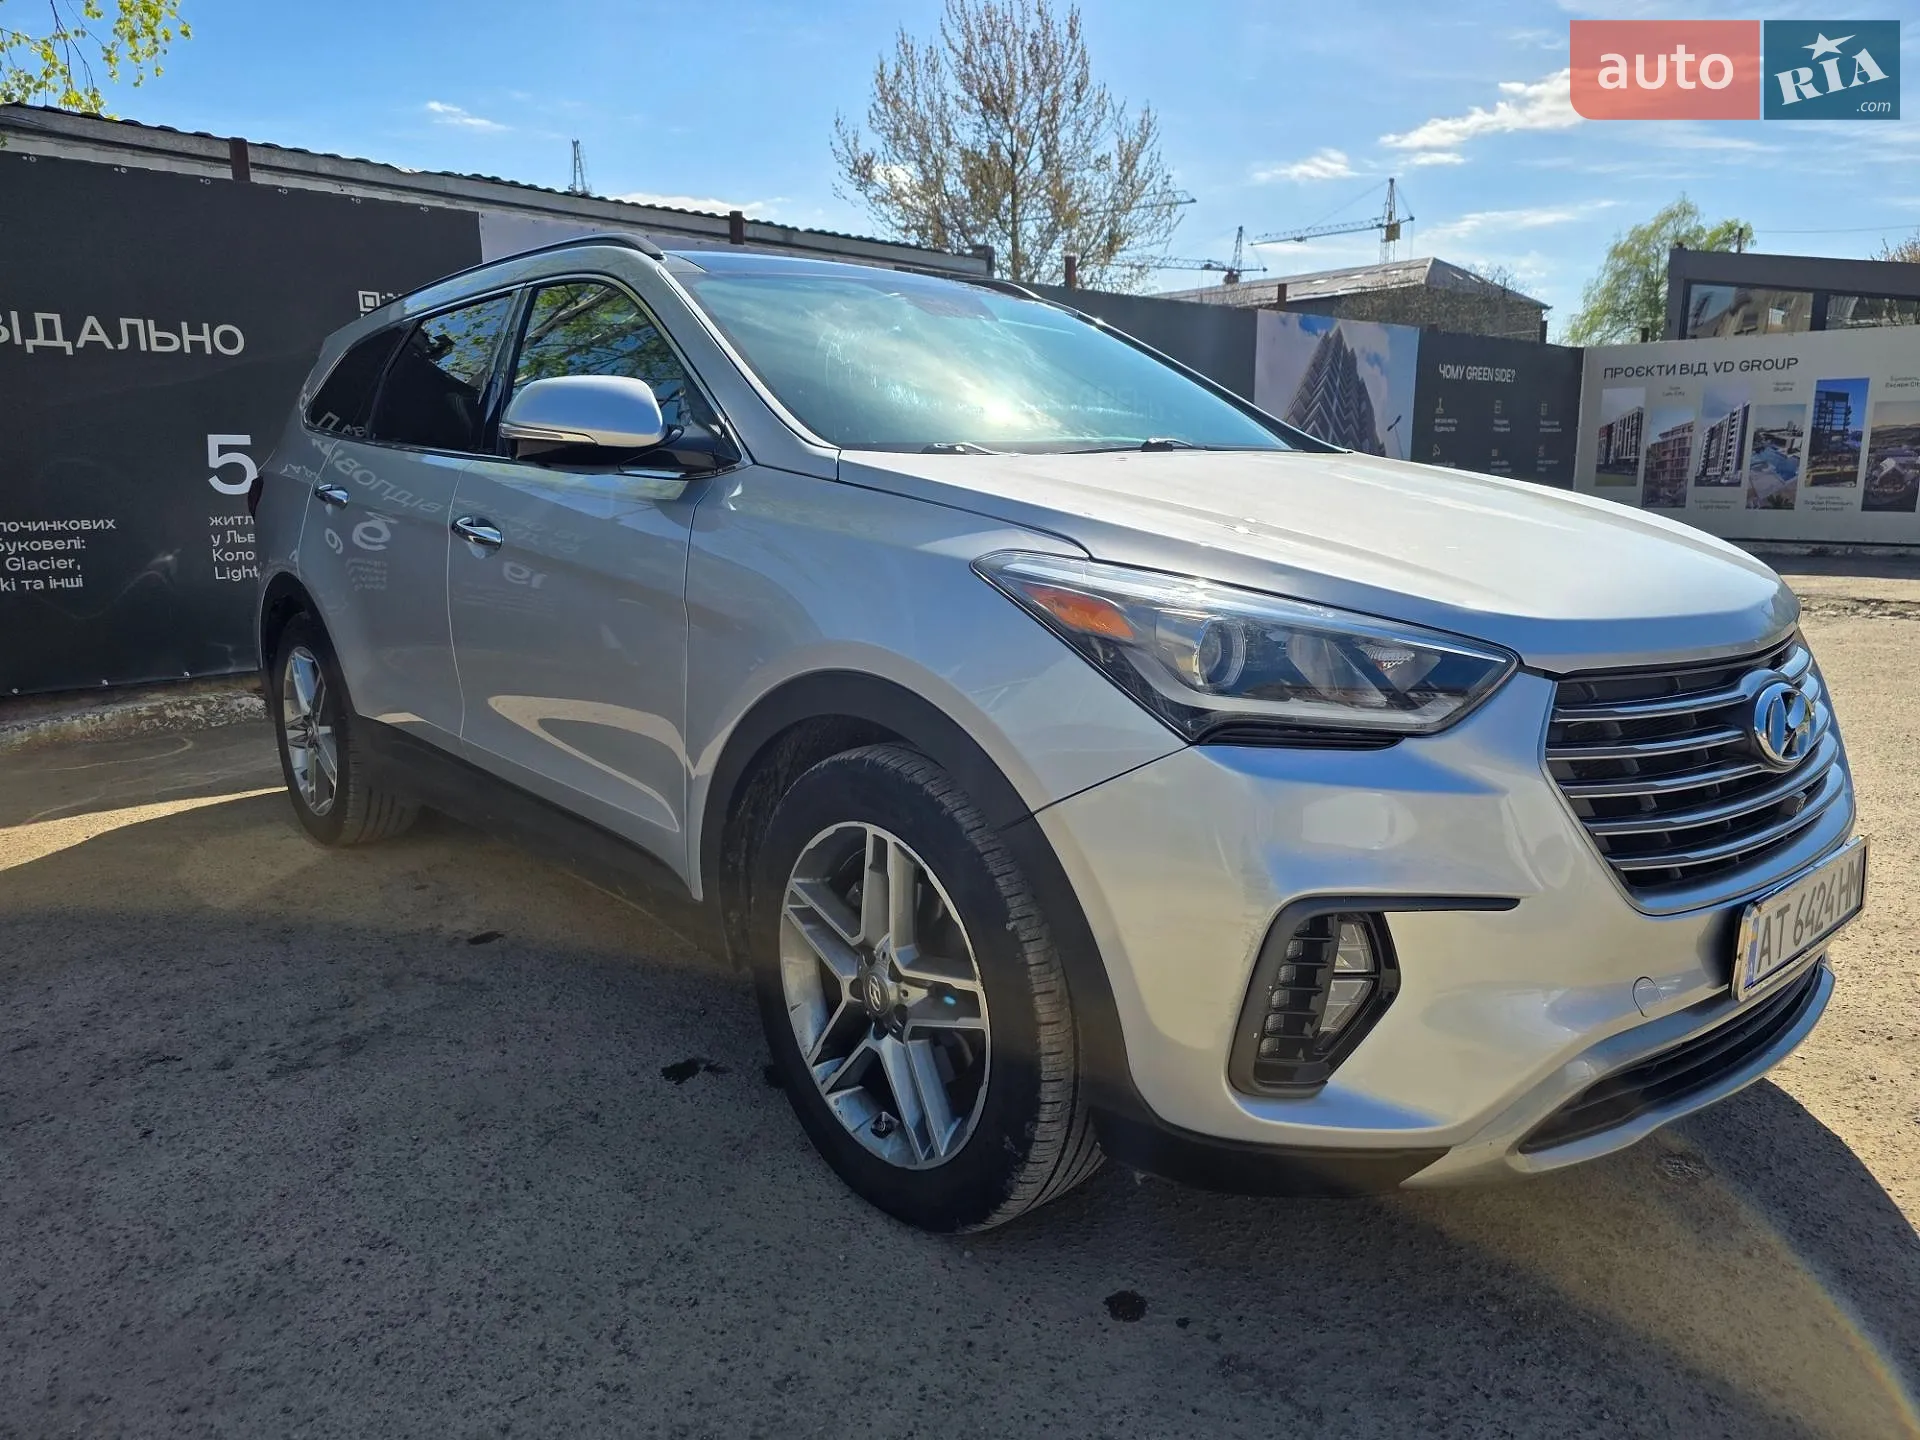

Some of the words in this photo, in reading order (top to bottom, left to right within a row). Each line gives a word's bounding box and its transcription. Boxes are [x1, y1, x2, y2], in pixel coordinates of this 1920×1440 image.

[1439, 363, 1465, 379] ЧОМУ
[1466, 366, 1493, 381] GREEN
[1495, 368, 1516, 382] SIDE?
[1603, 364, 1676, 380] ПРОЄКТИ
[1678, 362, 1708, 377] ВІД
[1713, 360, 1734, 373] VD
[1738, 357, 1799, 372] GROUP
[208, 434, 258, 495] 5
[210, 534, 221, 547] у
[5, 557, 81, 572] Glacier,
[214, 565, 258, 581] Light
[20, 580, 45, 590] та
[48, 575, 83, 589] інші
[1757, 903, 1791, 973] AT
[1793, 873, 1836, 947] 6424
